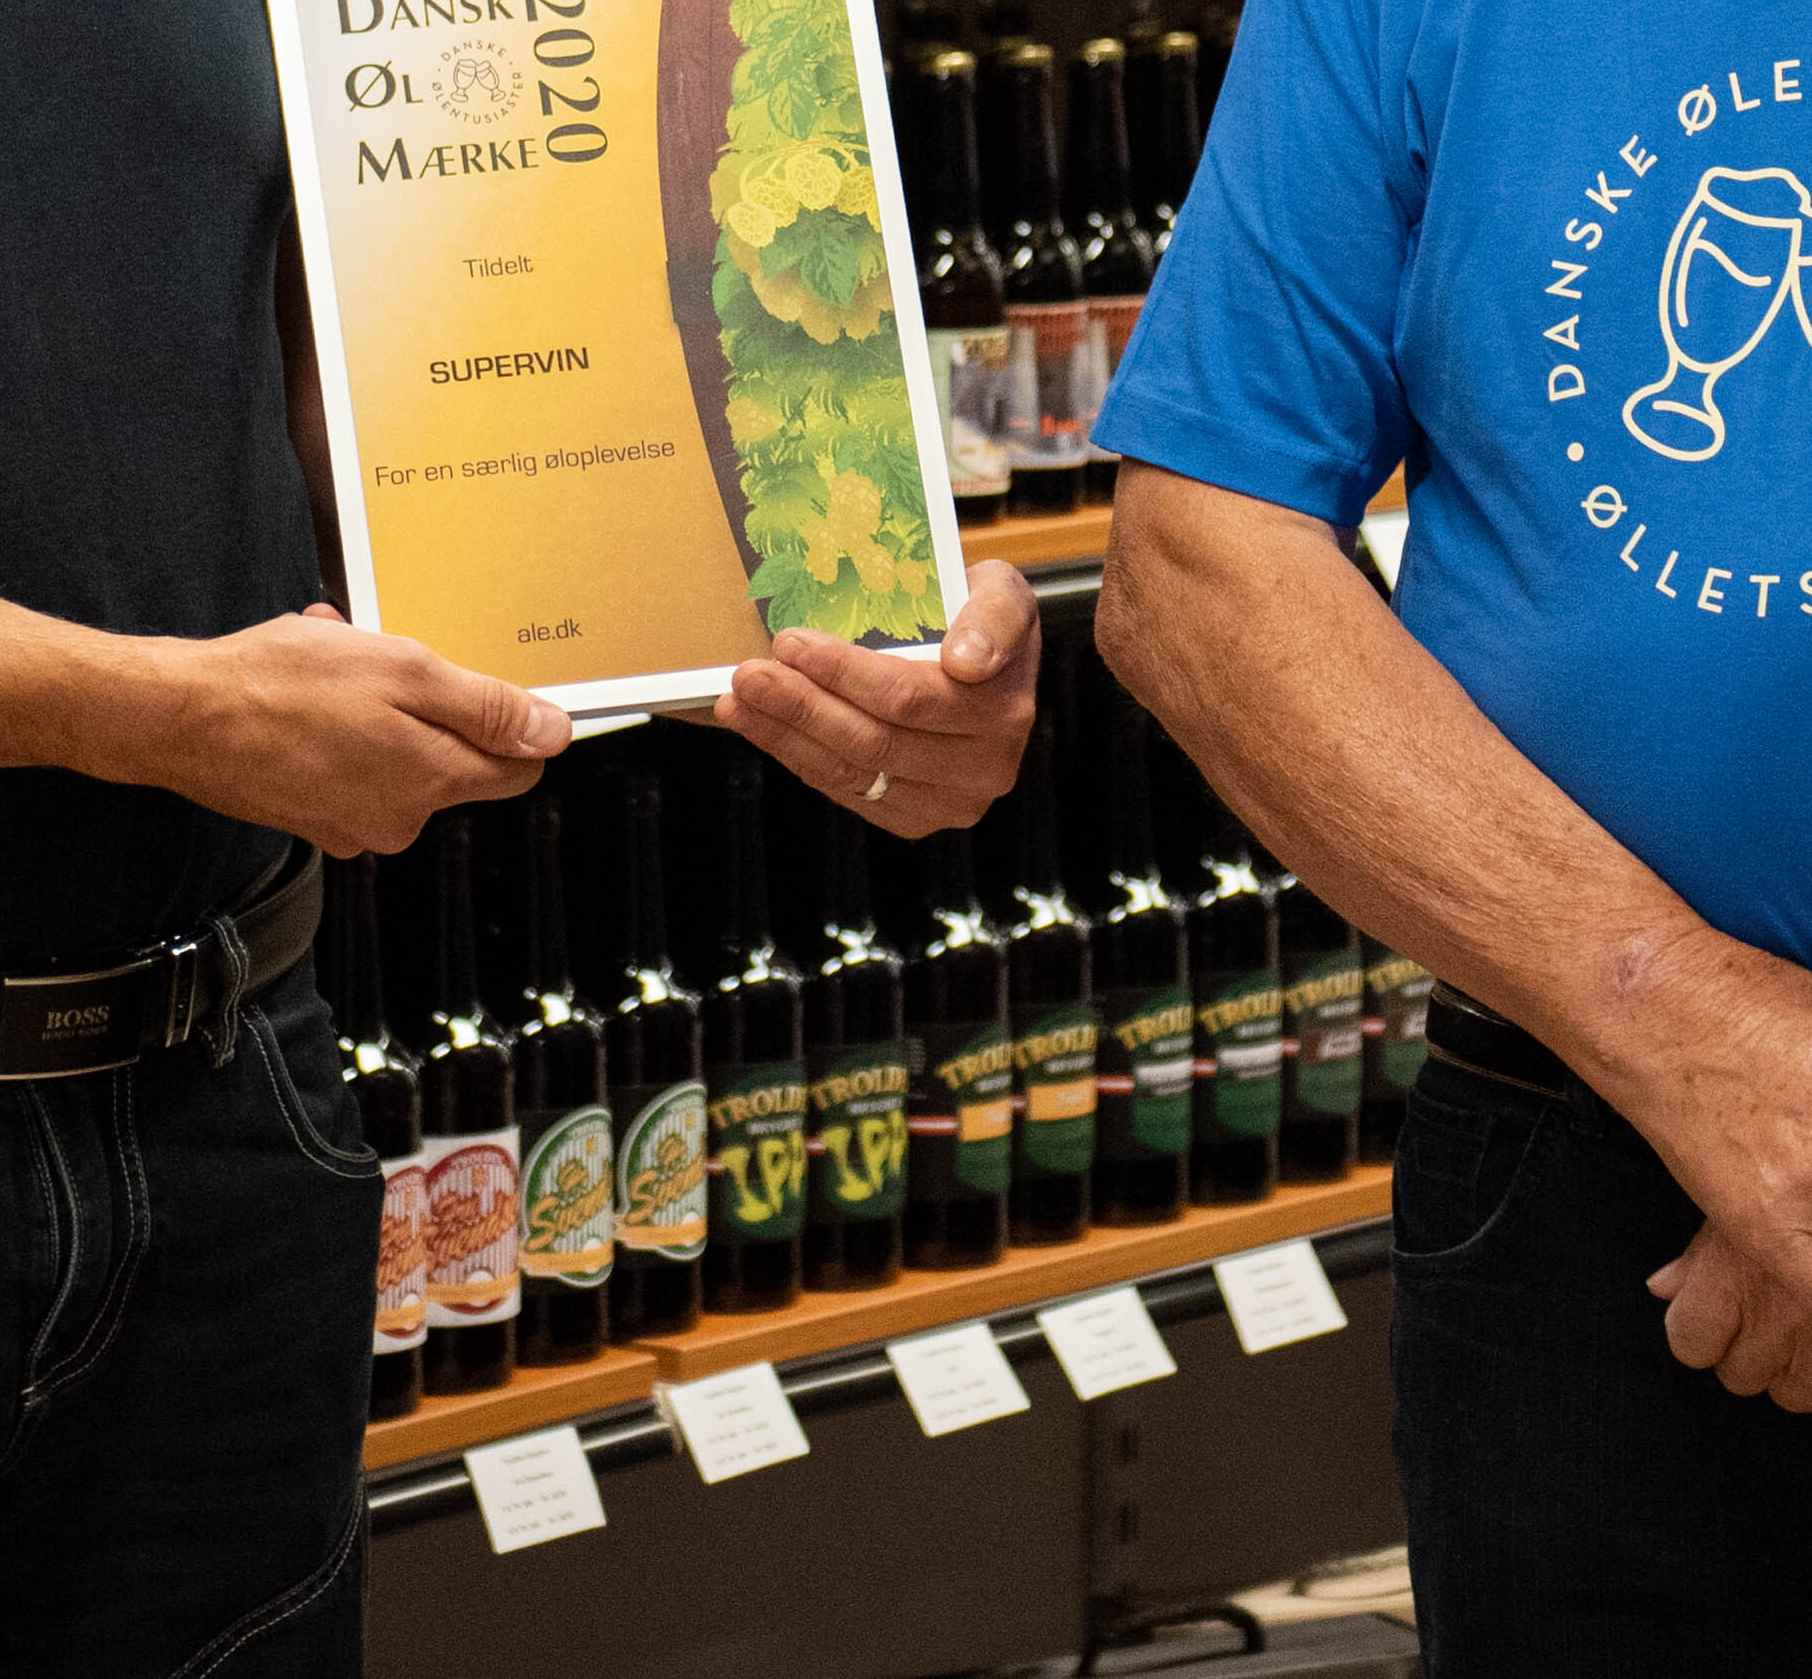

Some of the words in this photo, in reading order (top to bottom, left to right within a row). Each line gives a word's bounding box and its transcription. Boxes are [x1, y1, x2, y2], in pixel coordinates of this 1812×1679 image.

[463, 255, 534, 279] Tildelt
[1542, 134, 1659, 402] DANSKE
[429, 347, 590, 384] SUPERVIN
[374, 465, 417, 487] For
[424, 464, 453, 482] en
[461, 452, 538, 477] særlig
[544, 440, 676, 471] øloplevelse
[517, 620, 583, 644] ale.dk
[46, 1004, 110, 1029] BOSS
